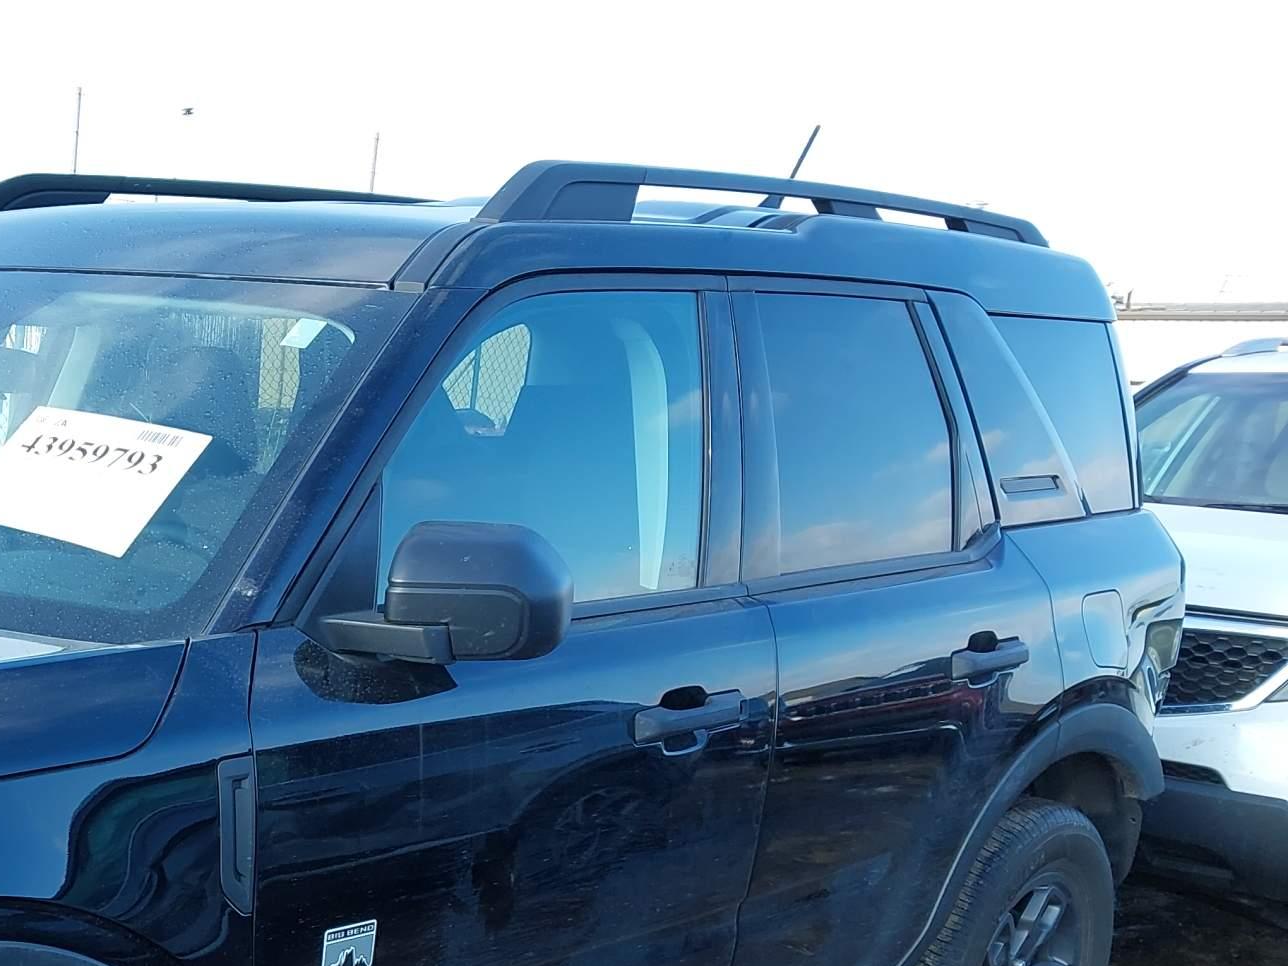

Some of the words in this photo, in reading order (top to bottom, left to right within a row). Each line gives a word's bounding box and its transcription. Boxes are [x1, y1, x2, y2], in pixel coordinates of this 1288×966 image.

[21, 434, 164, 475] 43959793
[328, 932, 345, 941] BIG
[347, 925, 374, 937] BEND
